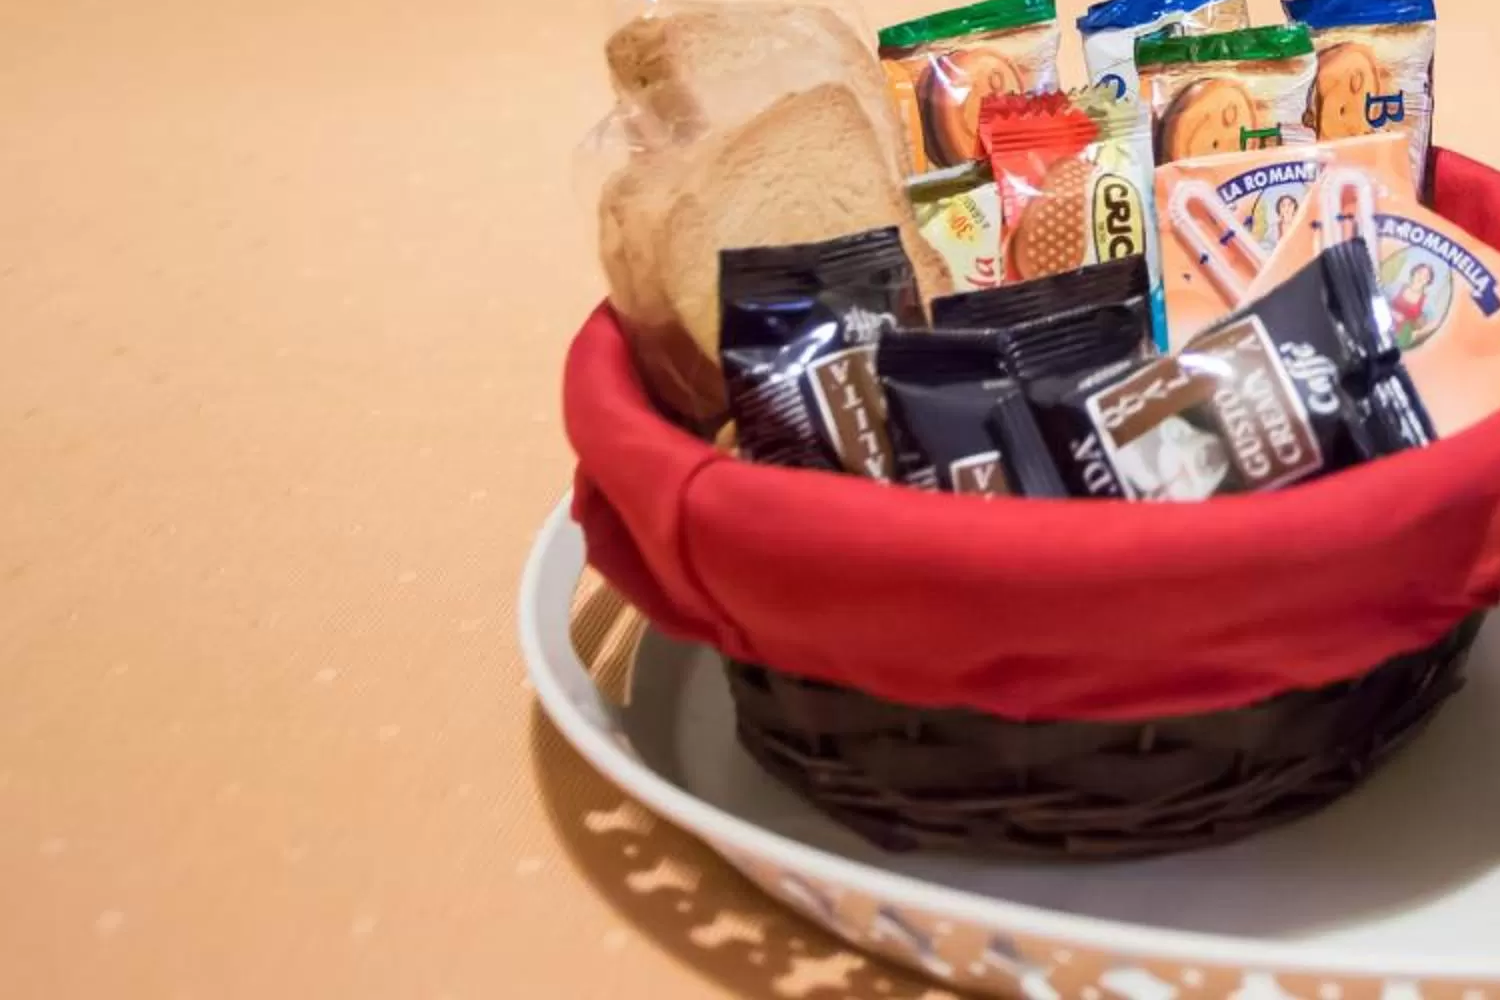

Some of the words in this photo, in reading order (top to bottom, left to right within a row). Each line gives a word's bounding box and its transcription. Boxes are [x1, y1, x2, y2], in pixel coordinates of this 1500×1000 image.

[1220, 185, 1243, 202] LA
[1396, 221, 1490, 291] ROMANELLA
[1279, 342, 1340, 414] Caffè
[1213, 388, 1271, 478] GUSTO
[1242, 369, 1302, 464] CREMA
